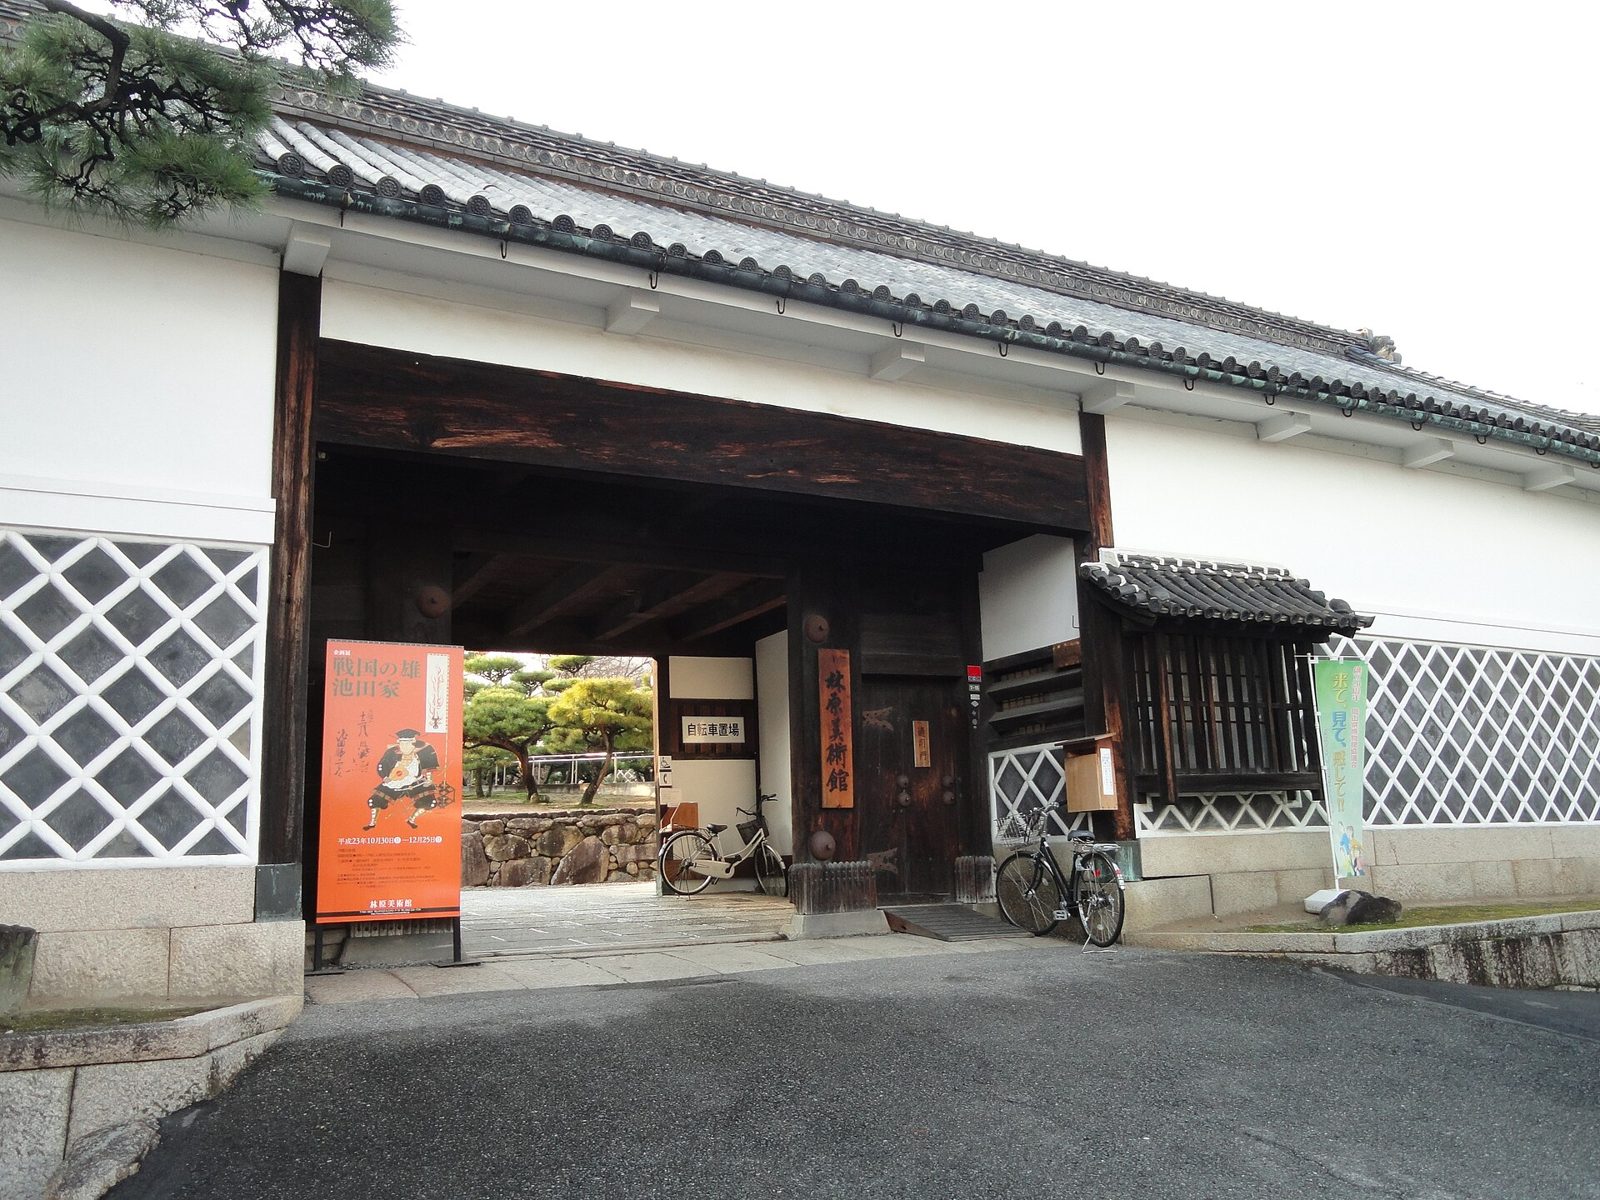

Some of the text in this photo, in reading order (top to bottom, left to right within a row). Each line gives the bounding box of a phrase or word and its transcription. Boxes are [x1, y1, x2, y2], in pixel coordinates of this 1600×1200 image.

[334, 657, 421, 679] 戦国の雄
[332, 678, 400, 697] 池田家
[687, 722, 740, 737] 自転車置場
[825, 670, 849, 792] 林原美術館
